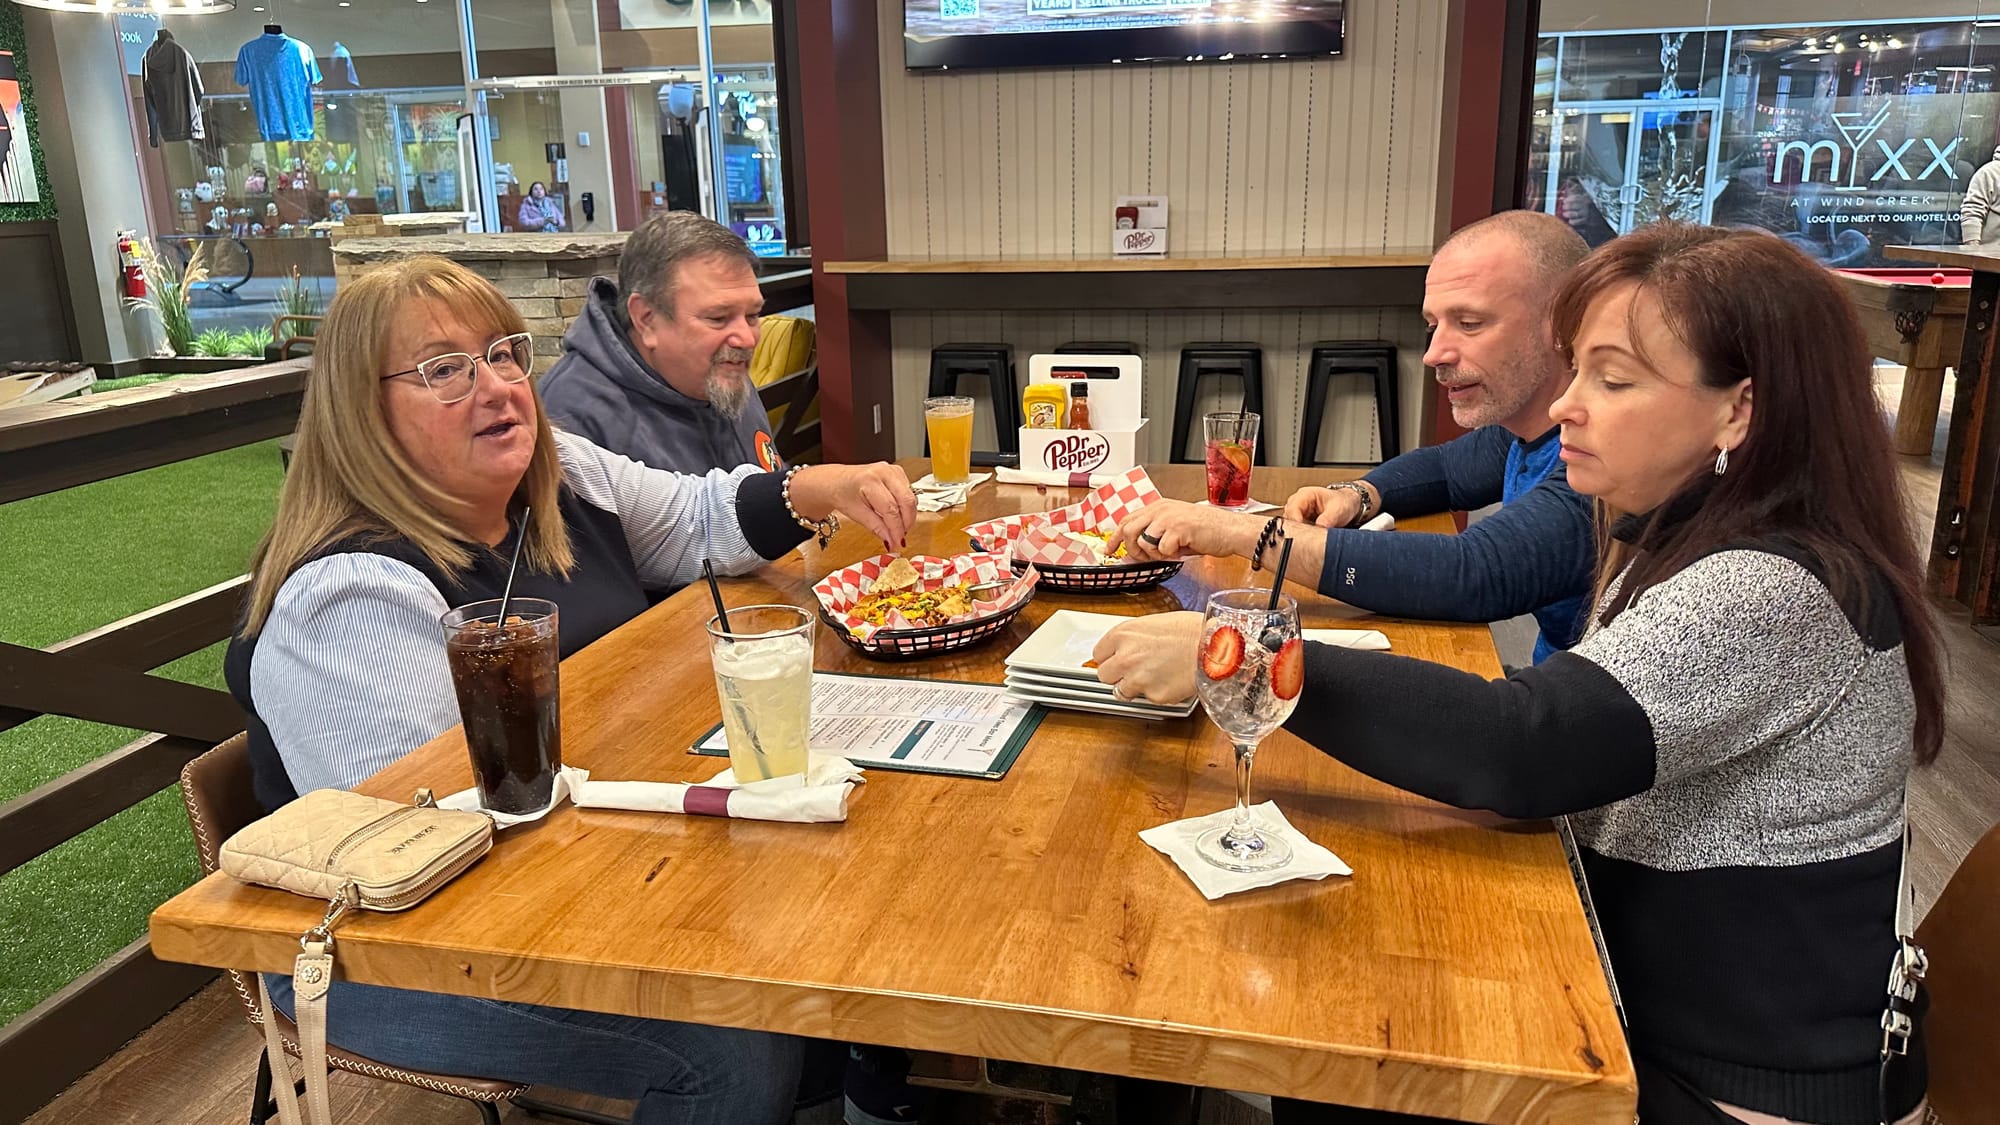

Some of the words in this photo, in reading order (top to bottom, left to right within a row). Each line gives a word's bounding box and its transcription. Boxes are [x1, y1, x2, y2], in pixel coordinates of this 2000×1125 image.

[1790, 198, 1810, 208] AT
[1821, 196, 1865, 207] WIND
[1875, 195, 1931, 206] CREEK
[1806, 214, 1849, 224] LOCATED
[1851, 213, 1875, 223] NEXT
[1878, 213, 1891, 222] TO
[1893, 213, 1913, 222] OUR
[1915, 212, 1945, 222] HOTEL
[1124, 234, 1153, 250] Pepper
[1134, 231, 1146, 241] Dr
[1066, 435, 1090, 455] Dr
[1044, 439, 1105, 471] Pepper
